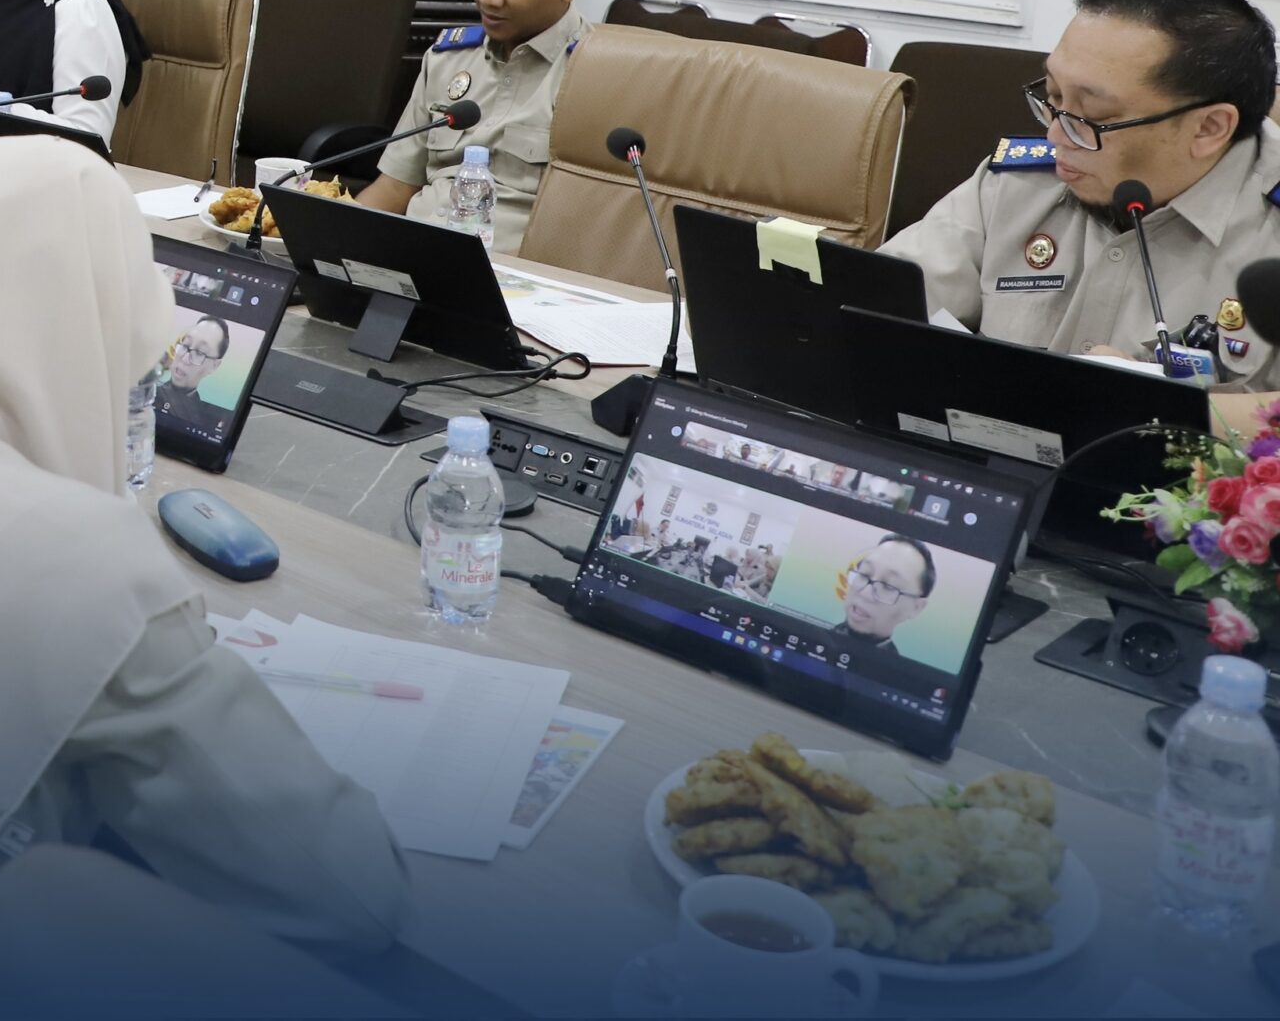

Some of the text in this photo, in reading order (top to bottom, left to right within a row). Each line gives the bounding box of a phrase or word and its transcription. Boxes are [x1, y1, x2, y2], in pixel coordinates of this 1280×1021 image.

[999, 279, 1063, 288] RAMADHAN FIRDAUS
[1169, 354, 1203, 368] SEO
[467, 560, 482, 574] Le
[441, 567, 495, 585] Minerale
